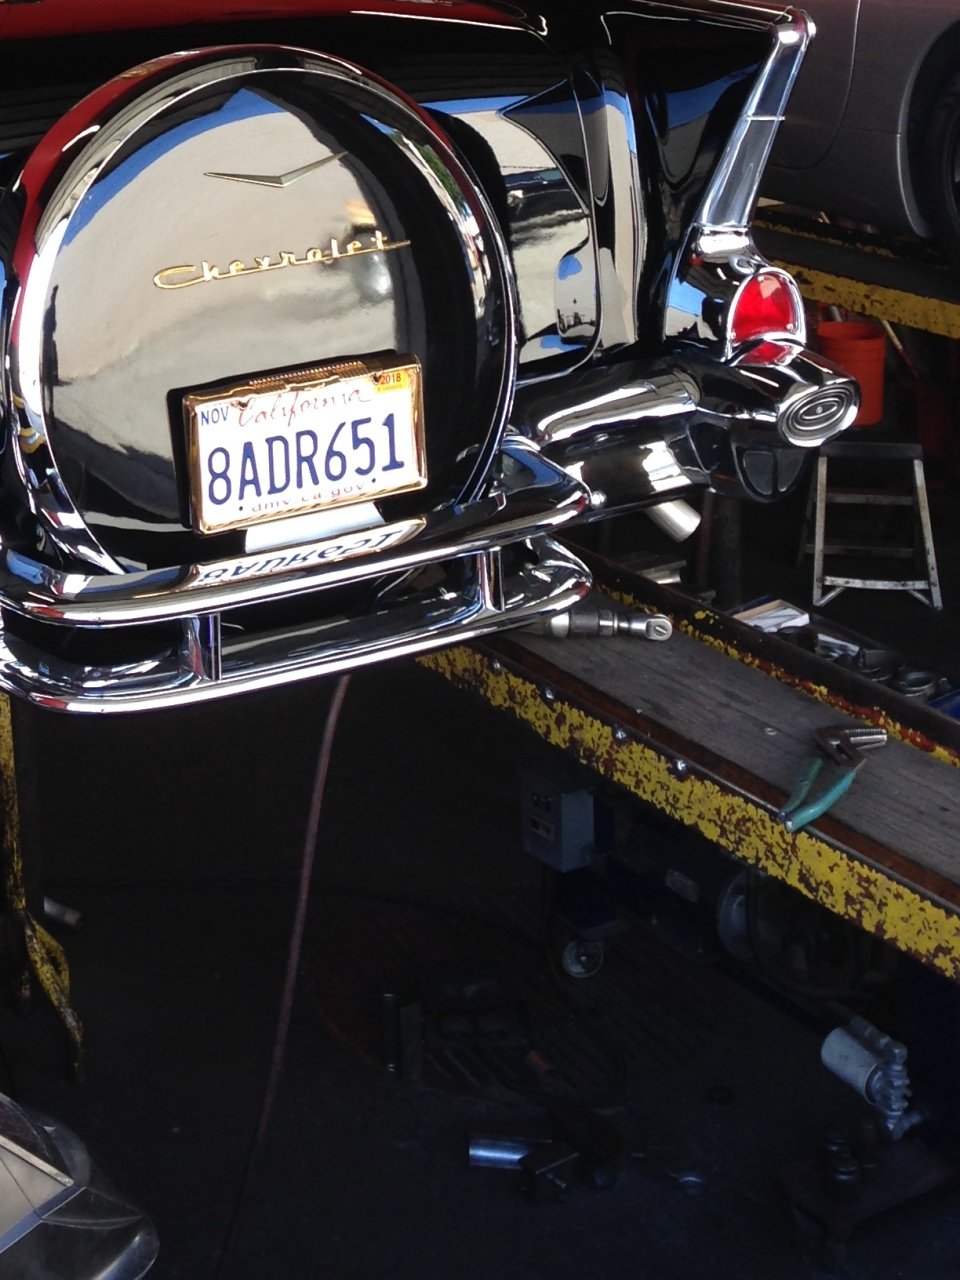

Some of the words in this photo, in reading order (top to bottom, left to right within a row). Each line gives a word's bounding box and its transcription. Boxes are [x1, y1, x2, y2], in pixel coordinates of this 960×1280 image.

[153, 230, 411, 289] Chevrolet
[380, 372, 402, 385] 2018
[200, 405, 231, 427] NOV
[239, 387, 373, 428] California
[208, 413, 405, 506] 8ADR651
